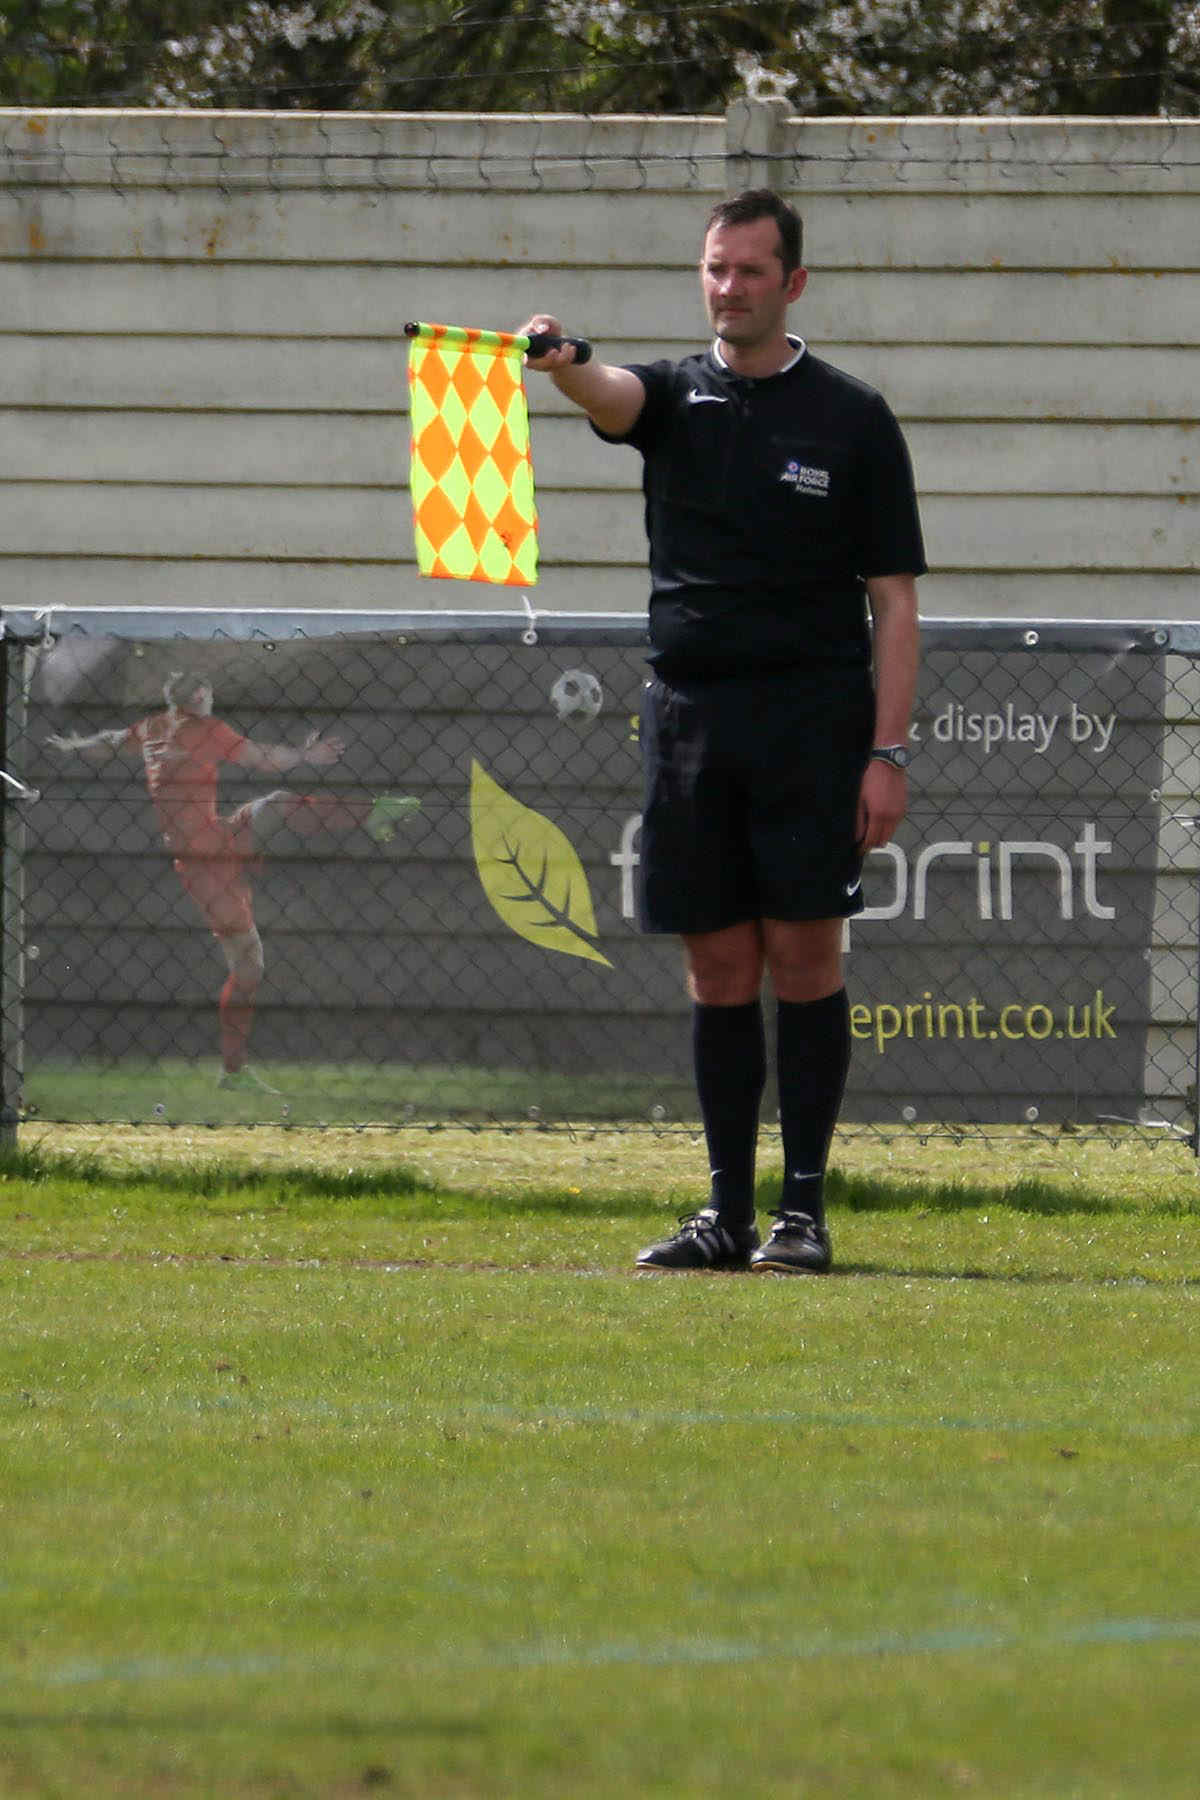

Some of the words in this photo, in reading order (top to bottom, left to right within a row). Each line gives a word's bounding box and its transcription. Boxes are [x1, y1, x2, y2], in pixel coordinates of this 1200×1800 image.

[934, 703, 1058, 753] display
[1072, 703, 1117, 753] by
[850, 989, 1118, 1054] eprint.co.uk
